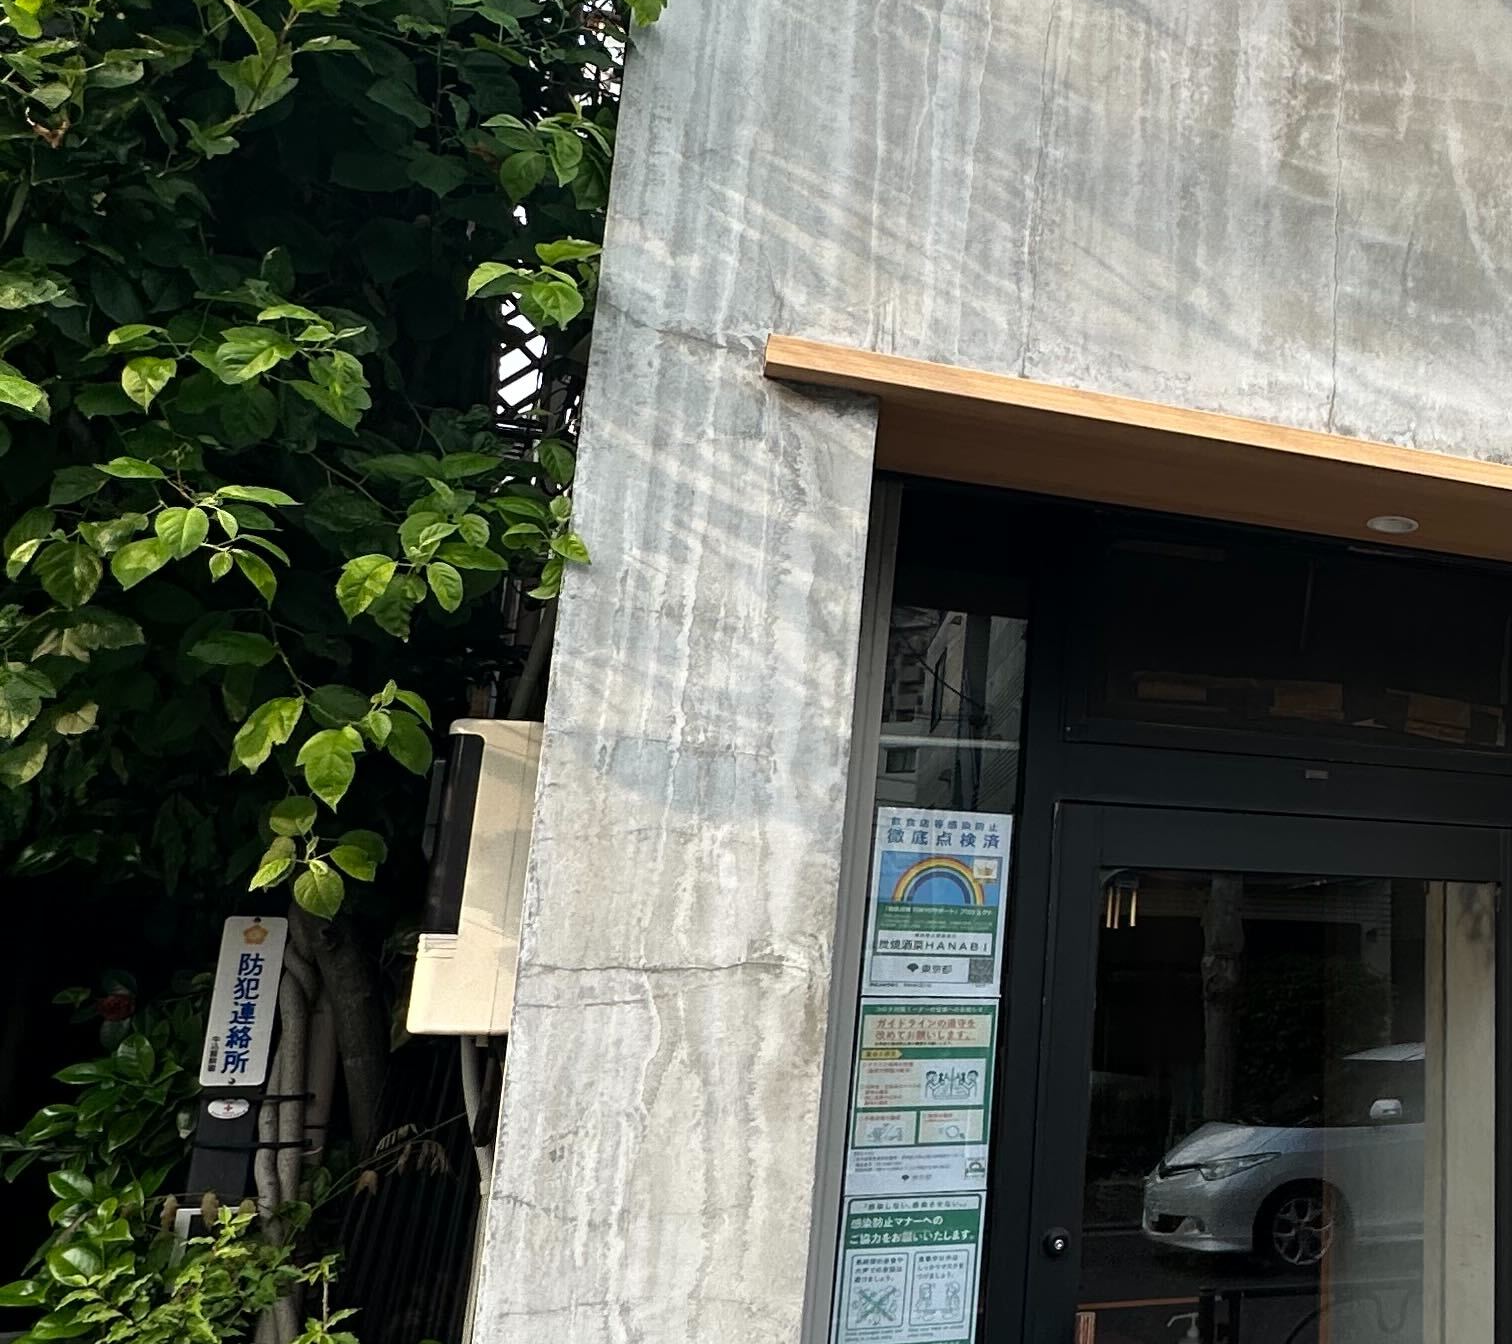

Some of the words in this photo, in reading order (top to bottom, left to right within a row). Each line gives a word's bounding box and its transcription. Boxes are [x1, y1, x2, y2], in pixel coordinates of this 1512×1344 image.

[887, 828, 1000, 849] 徹底点検済
[221, 953, 265, 1074] 防犯連絡所
